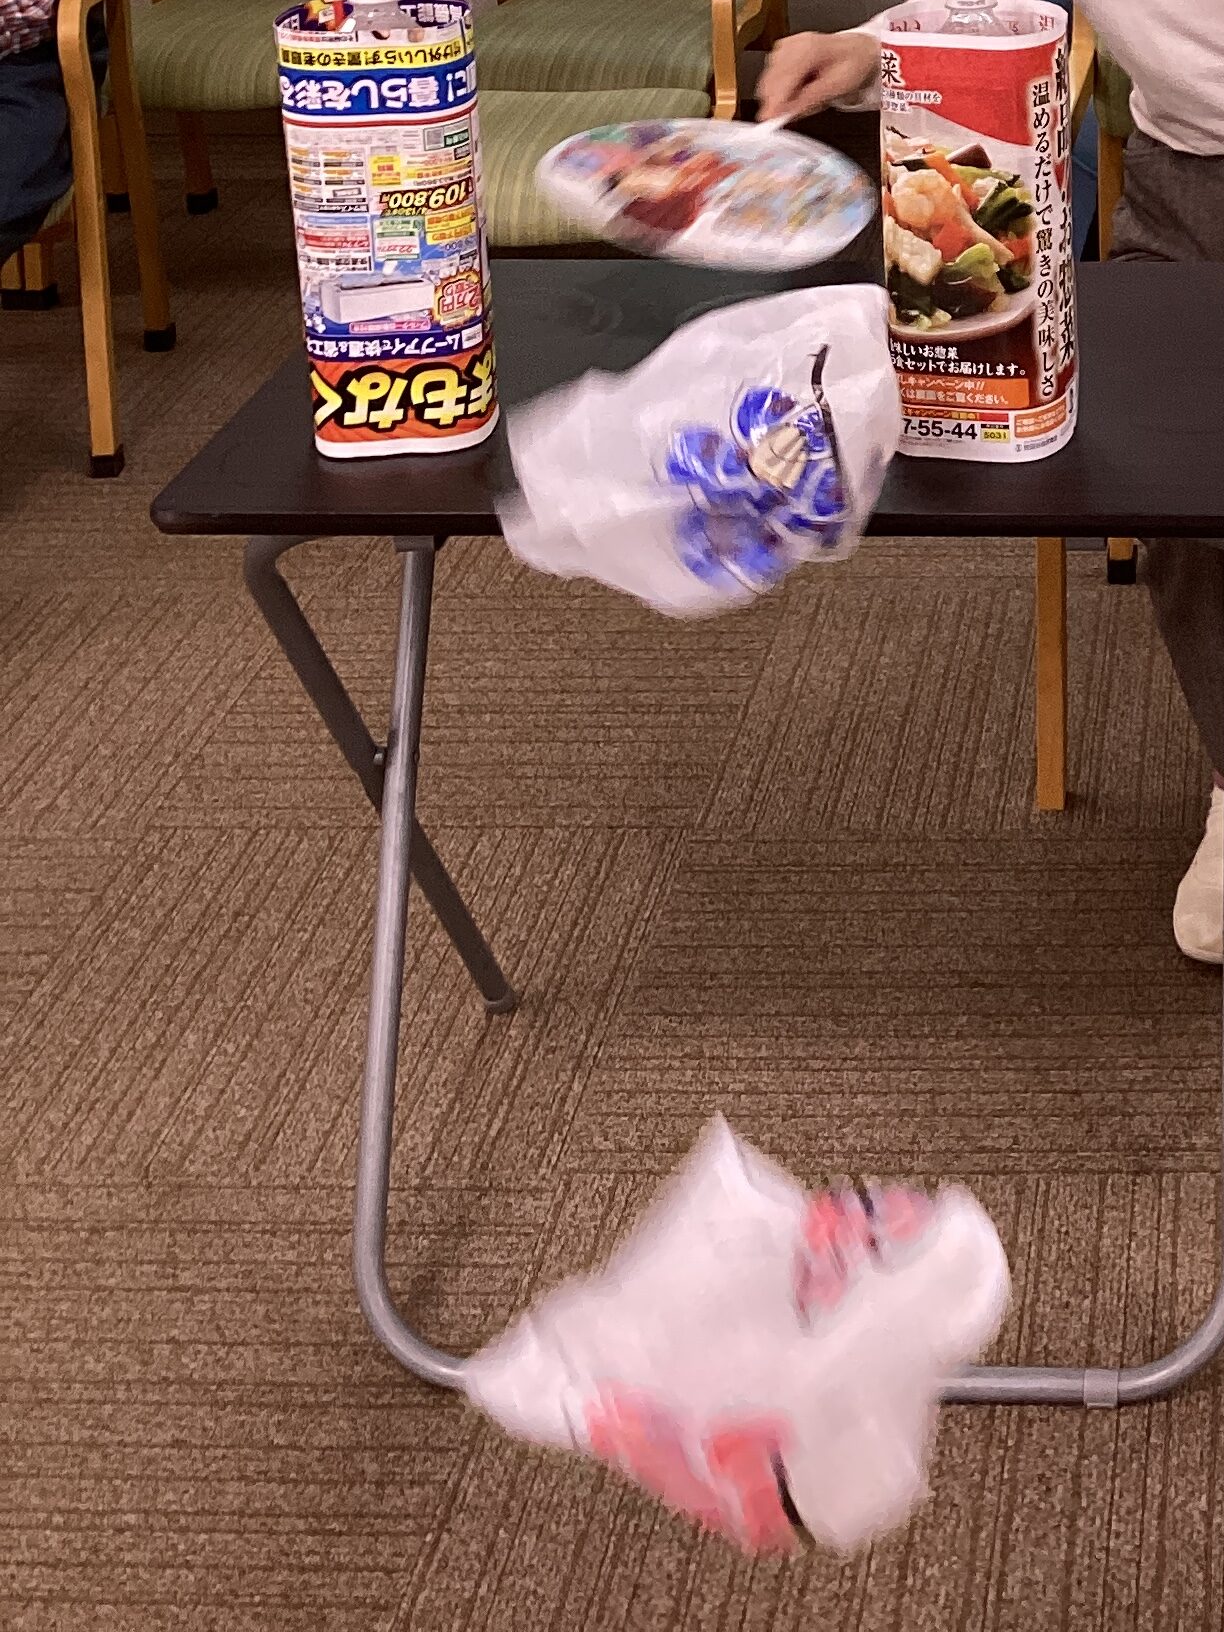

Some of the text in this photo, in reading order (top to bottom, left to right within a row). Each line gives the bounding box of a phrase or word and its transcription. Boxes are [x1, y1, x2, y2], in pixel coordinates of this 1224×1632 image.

[1032, 81, 1056, 397] 温めるだけで驚きの美味しさ
[902, 418, 978, 440] 7-55-44
